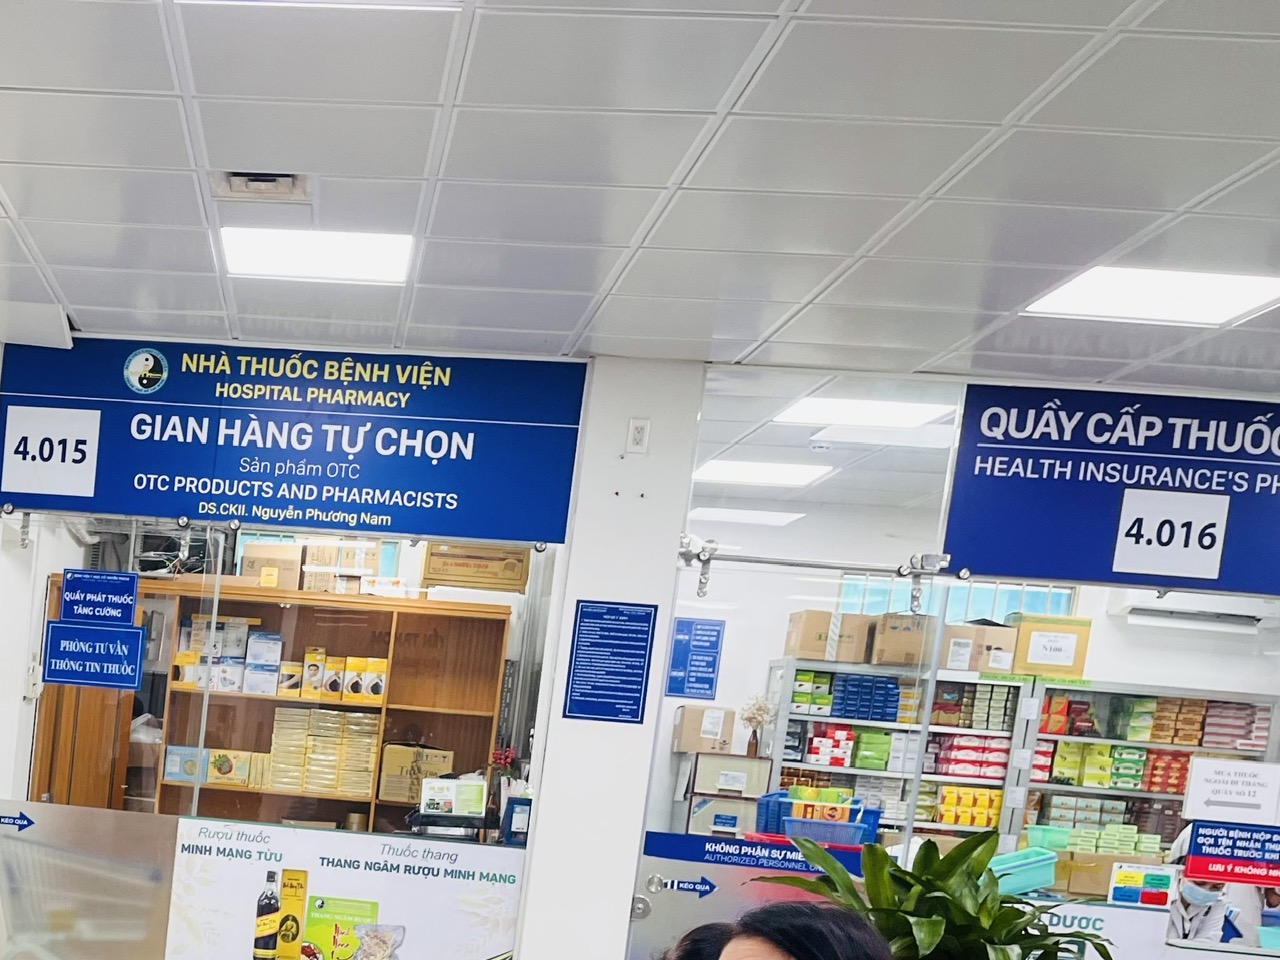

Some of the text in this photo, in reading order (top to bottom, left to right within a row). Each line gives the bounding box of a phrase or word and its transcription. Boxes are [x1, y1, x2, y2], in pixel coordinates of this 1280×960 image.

[181, 351, 231, 375] NHÀ
[236, 353, 318, 380] THUỐC
[324, 357, 390, 386] BỆNH
[396, 361, 451, 390] VIỆN
[215, 382, 410, 408] HOSPITAL PHARMACY
[979, 398, 1163, 446] QUẦY CẤP
[130, 413, 475, 465] GIAN HÀNG TỰ CHỌN
[13, 435, 88, 464] 4.015
[239, 457, 361, 479] Sản phẩm OTC
[973, 455, 1249, 493] HEALTH INSURANCE'S
[134, 473, 458, 510] OTC PRODUCTS AND PHARMACISTS
[198, 502, 391, 526] DS.CKII. Nguyễn Phương Nam
[1124, 517, 1217, 550] 4.016
[86, 591, 133, 604] PHÁT THUỐC
[73, 604, 122, 617] TĂNG CƯỜNG
[60, 638, 108, 654] PHÒNG TƯ
[50, 658, 83, 672] THÔNG
[84, 661, 101, 673] TIN
[198, 826, 271, 844] Rượu thuốc
[1197, 837, 1233, 846] GỌI TÊN
[1198, 827, 1228, 837] NGƯỜI
[1229, 829, 1251, 839] BỆNH
[181, 843, 252, 861] MINH MẠNG
[380, 843, 459, 864] Thuốc thang
[705, 842, 786, 860] KHÔNG PHẬN SỰ
[1201, 845, 1232, 856] THUỐC
[1264, 852, 1280, 860] KHI
[319, 856, 516, 885] THANG NGÂM RƯỢU MINH MẠNG
[704, 853, 756, 866] AUTHORIZED
[758, 858, 808, 871] PERSONNEL
[1208, 863, 1267, 875] LƯU Ý KHÔNG
[695, 883, 710, 891] QUA
